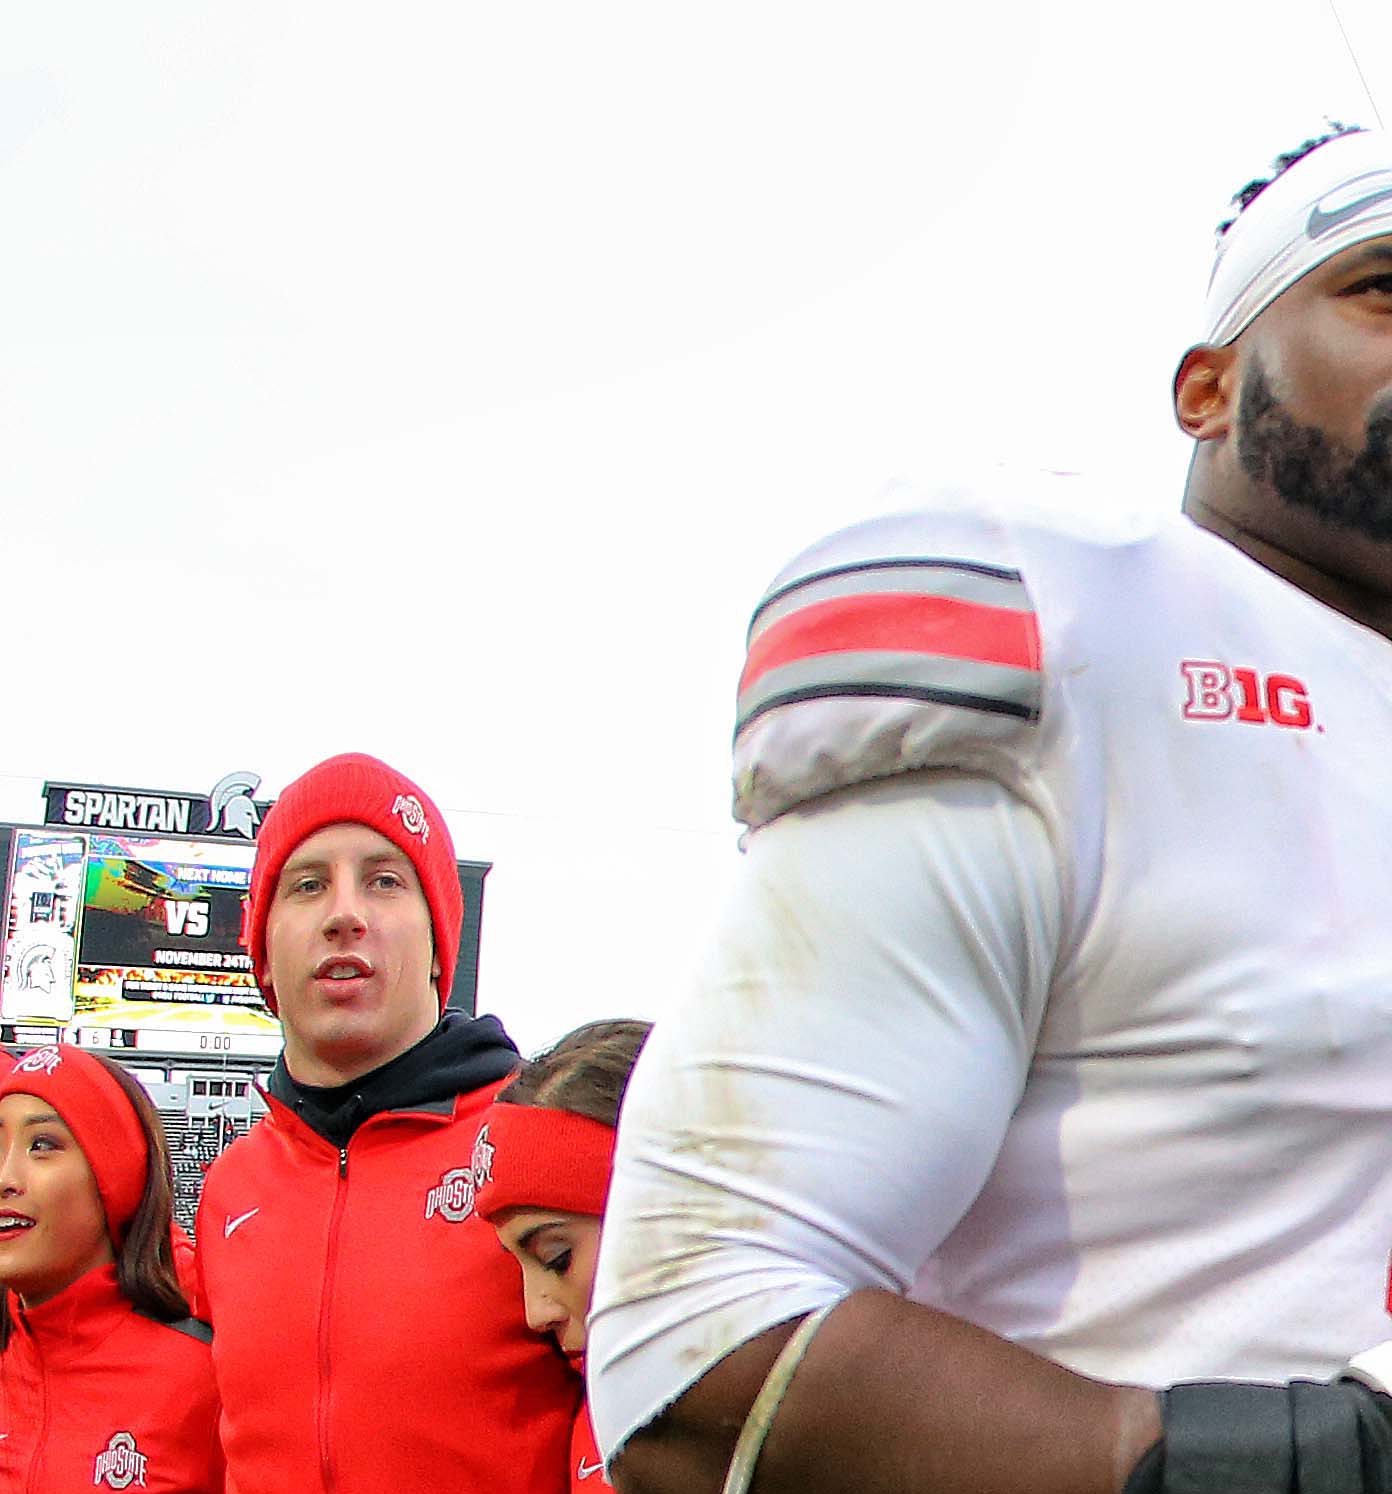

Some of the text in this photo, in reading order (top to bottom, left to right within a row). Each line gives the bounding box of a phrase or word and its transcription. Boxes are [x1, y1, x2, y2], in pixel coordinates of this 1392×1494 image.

[64, 790, 191, 833] SPARTAN
[177, 867, 247, 885] NEXT HOME
[164, 899, 209, 937] VS
[154, 950, 222, 969] NOVEMBER
[199, 1035, 231, 1050] 0:00
